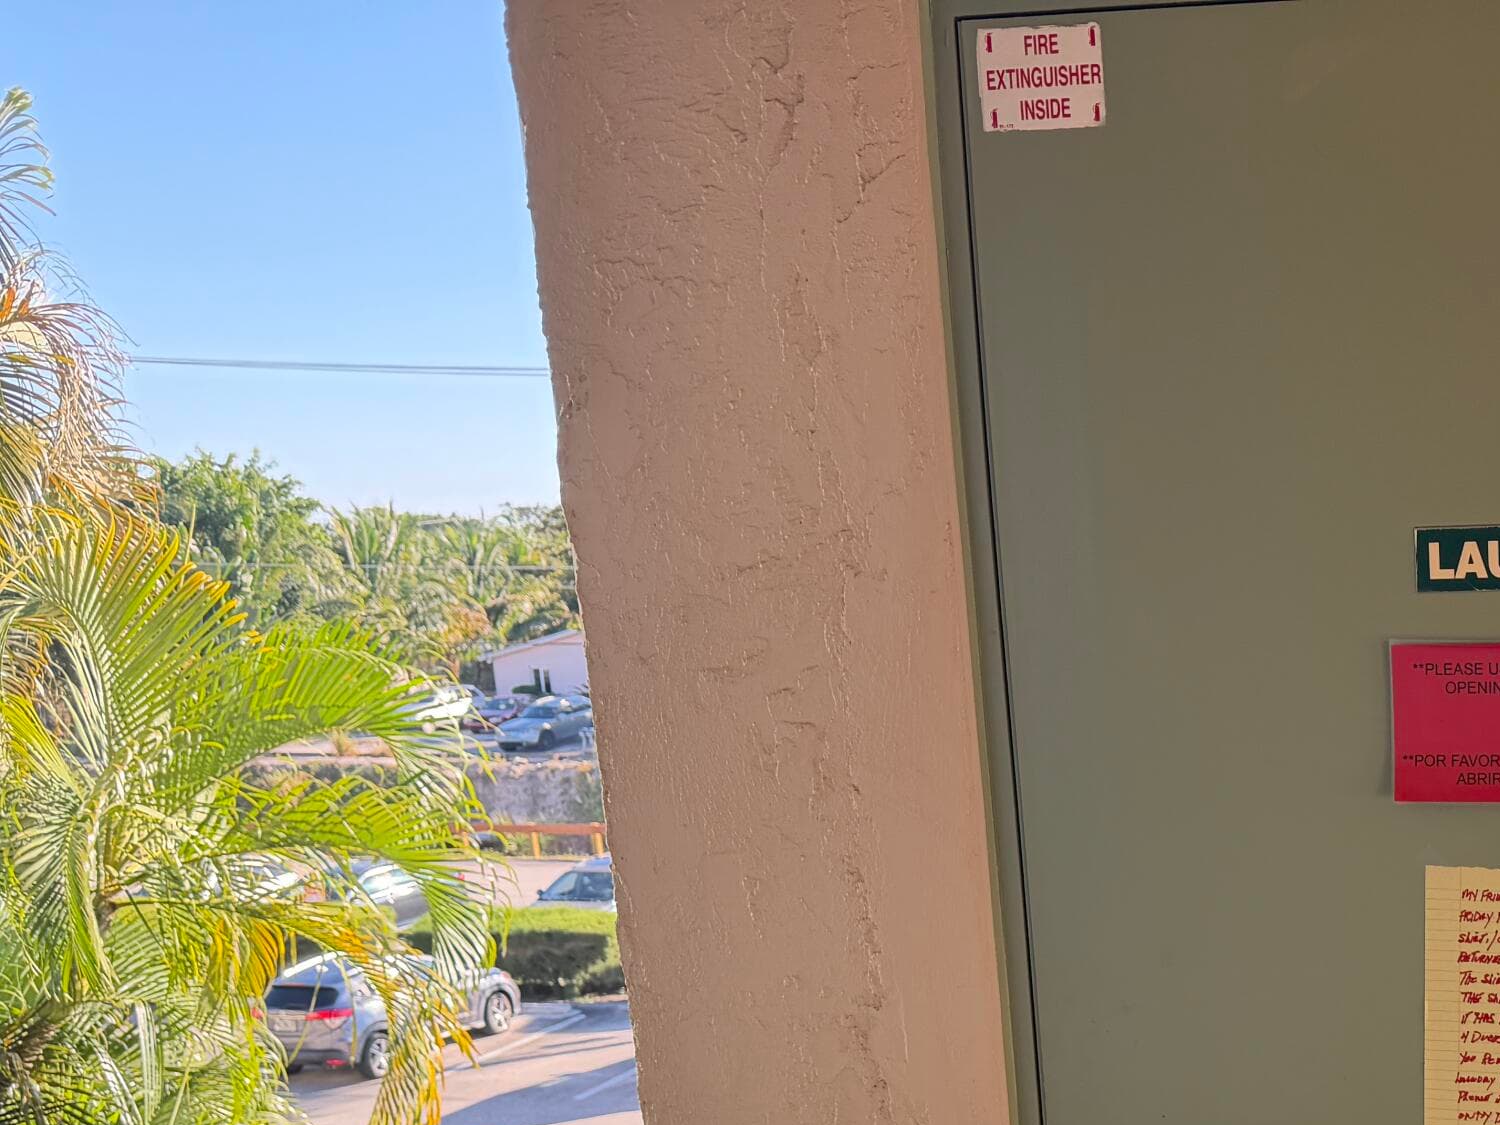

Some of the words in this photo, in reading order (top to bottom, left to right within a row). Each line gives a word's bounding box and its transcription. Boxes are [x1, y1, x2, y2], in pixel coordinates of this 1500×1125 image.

[1024, 34, 1059, 55] FIRE
[986, 64, 1101, 90] EXTINGUISHER
[1020, 98, 1071, 120] INSIDE
[1462, 889, 1478, 901] MY
[1461, 1031, 1469, 1043] 4
